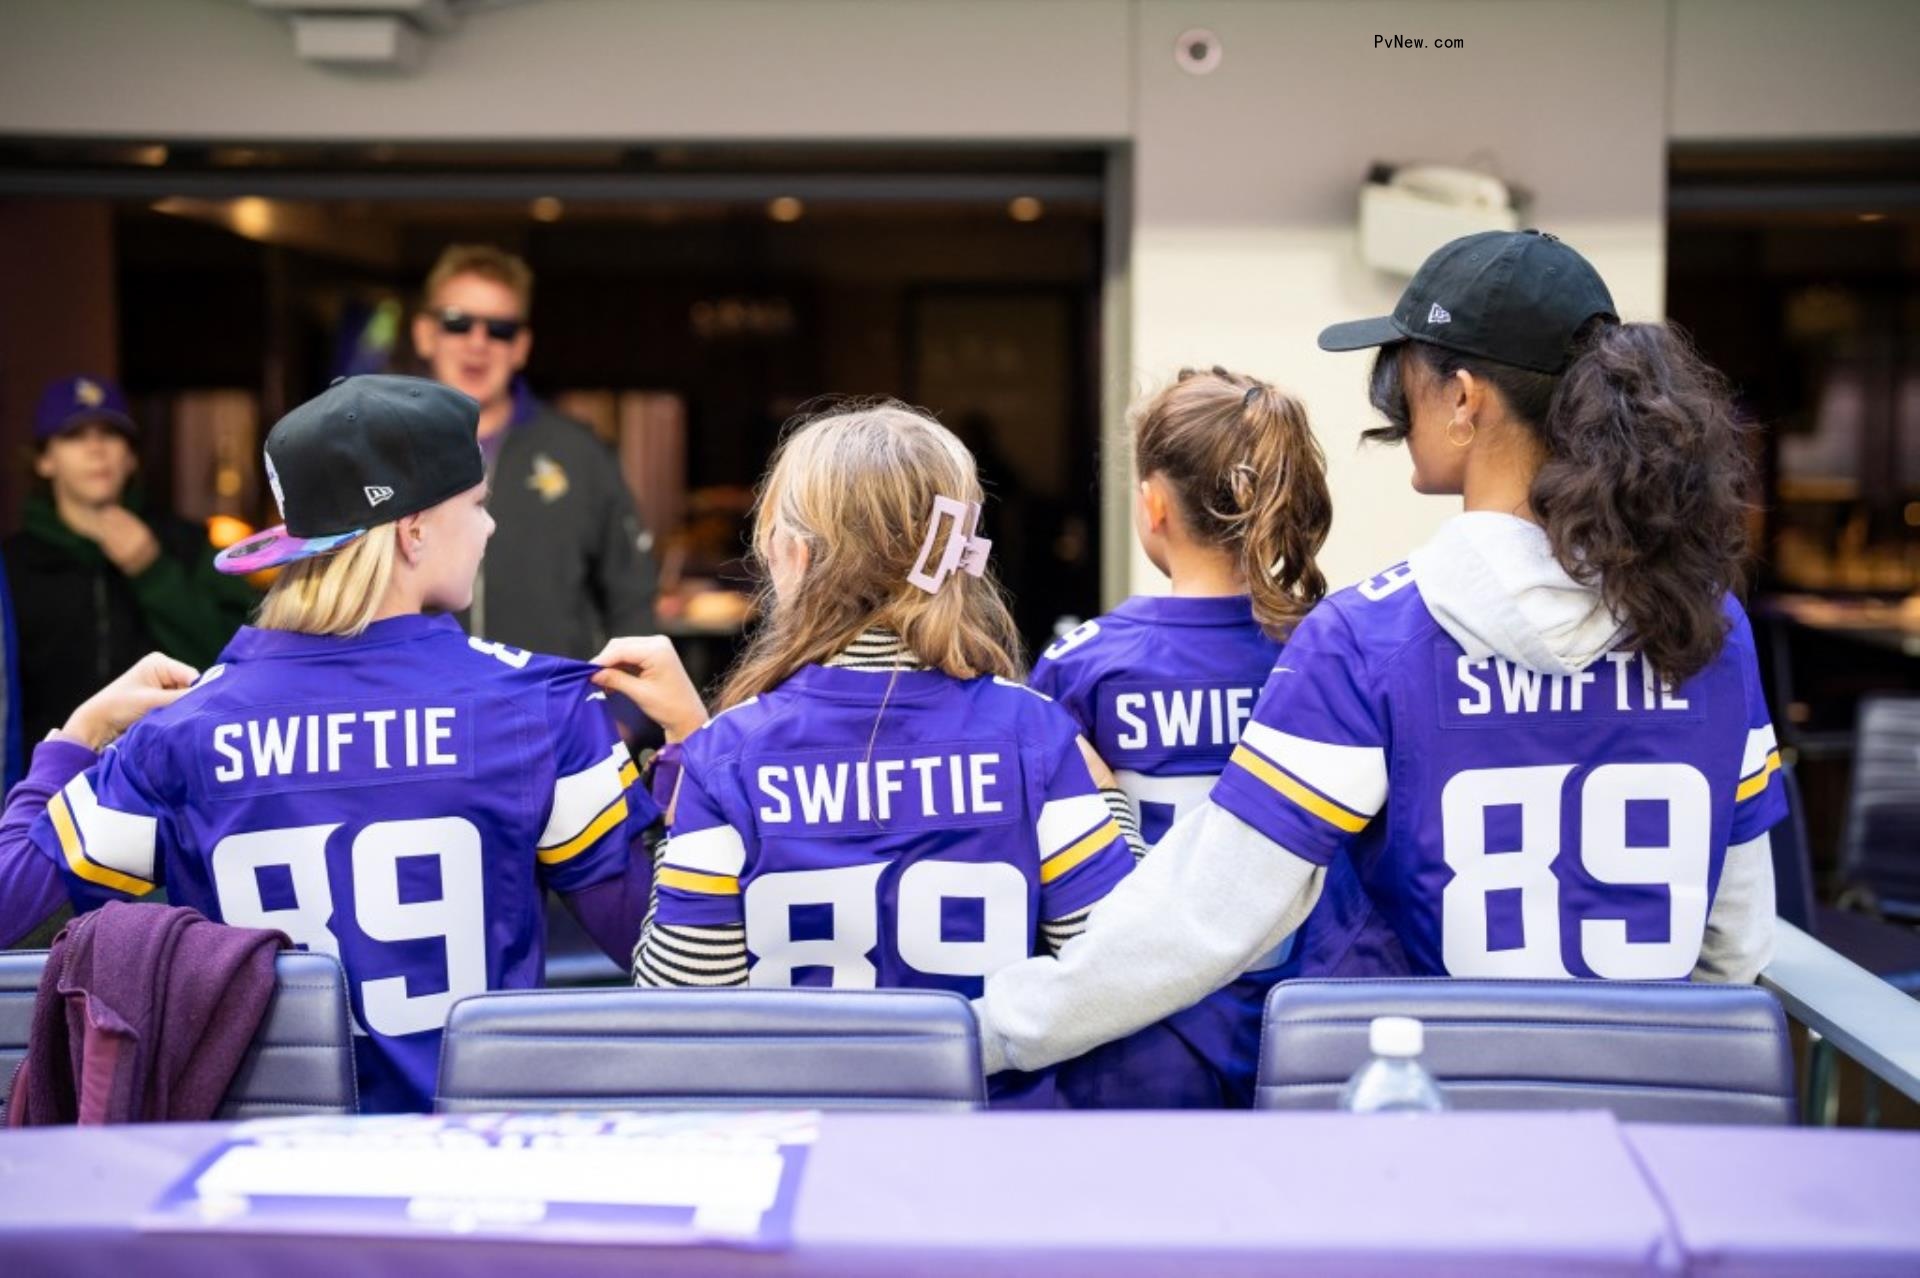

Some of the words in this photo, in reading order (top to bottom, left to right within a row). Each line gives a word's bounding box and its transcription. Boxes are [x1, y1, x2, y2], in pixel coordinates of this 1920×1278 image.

[1043, 619, 1101, 661] 9
[213, 707, 458, 783] SWIFTIE
[1116, 687, 1264, 750] SWIF
[757, 753, 1003, 824] SWIFTIE
[1441, 762, 1712, 981] 89
[212, 816, 487, 1037] 89
[744, 859, 1028, 998] 89
